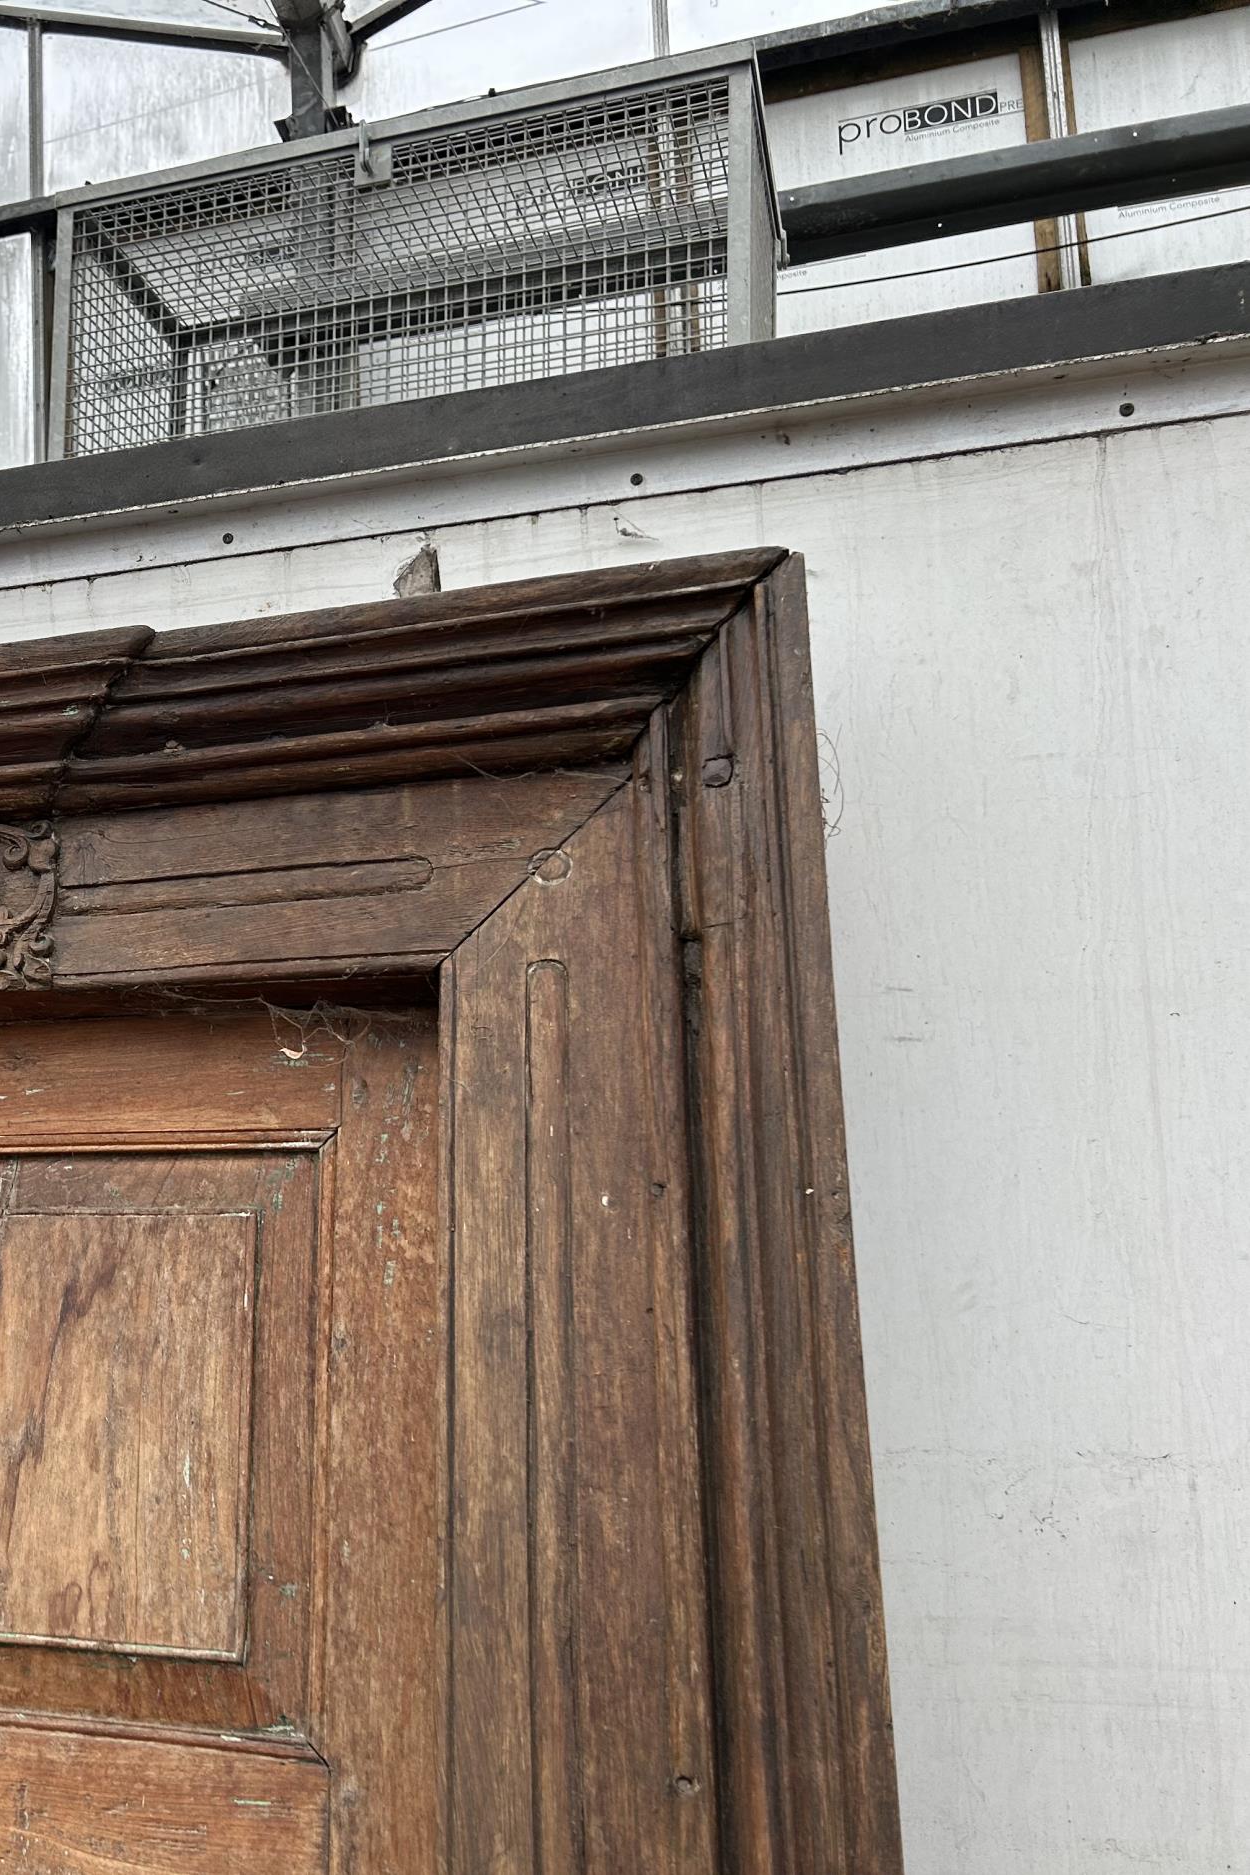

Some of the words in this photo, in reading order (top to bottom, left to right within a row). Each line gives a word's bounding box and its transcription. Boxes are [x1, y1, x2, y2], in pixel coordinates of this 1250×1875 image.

[838, 94, 997, 155] proBOND
[904, 127, 951, 142] Aluminium
[952, 118, 1000, 134] Composite
[1118, 205, 1167, 219] Aluminium
[1169, 196, 1221, 211] Composite
